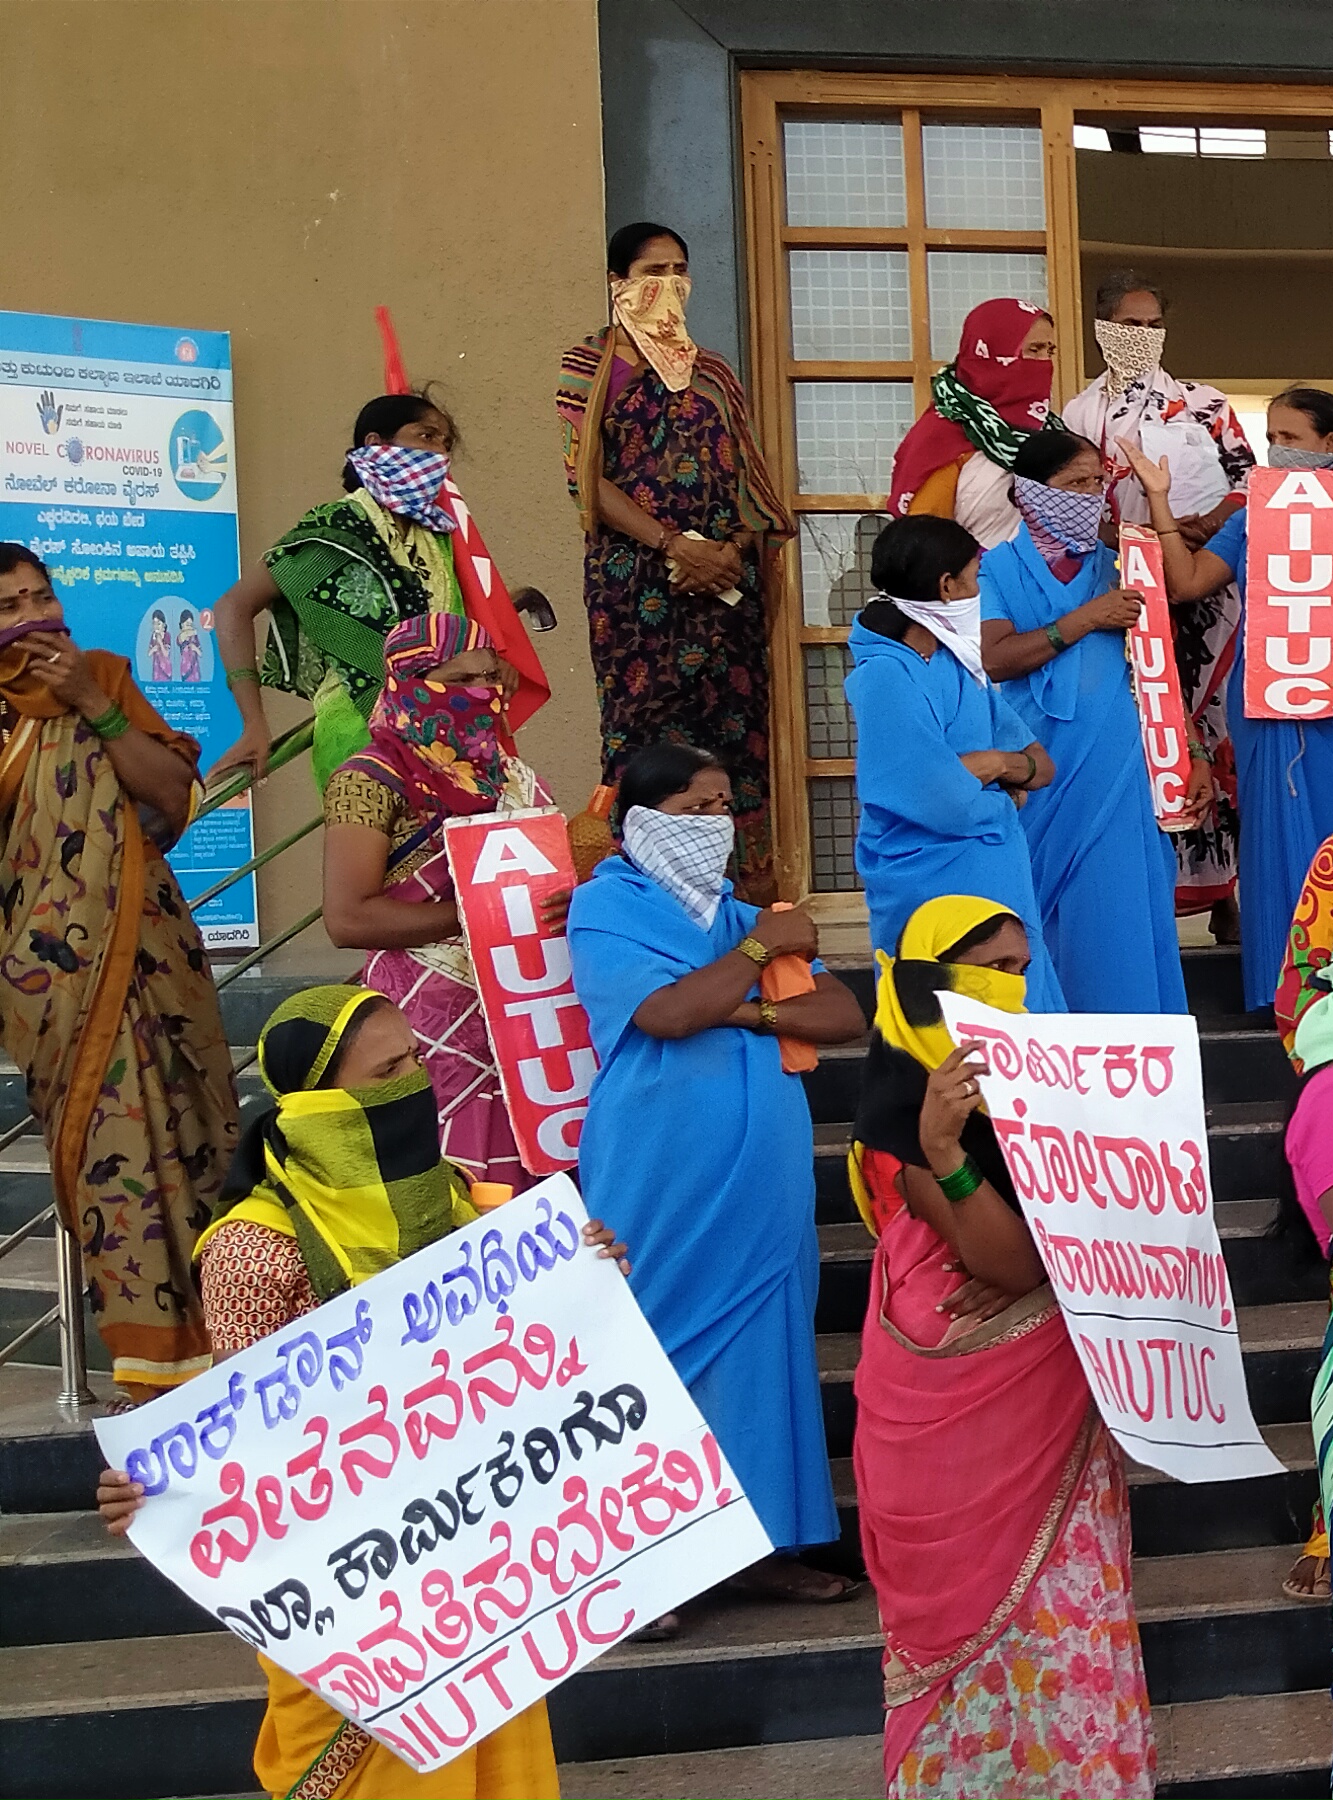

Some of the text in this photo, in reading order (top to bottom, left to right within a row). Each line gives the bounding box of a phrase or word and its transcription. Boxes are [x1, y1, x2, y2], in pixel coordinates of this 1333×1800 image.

[165, 376, 221, 390] ಯಾದಗಿರಿ
[6, 441, 49, 456] NOVEL
[122, 465, 163, 478] COVID-19
[64, 476, 118, 496] ಕರೋನಾ
[122, 479, 161, 505] ವೈರಸ್
[203, 610, 212, 629] 2
[208, 930, 250, 942] ಯಾದಗಿರಿ
[1079, 1333, 1226, 1425] AIUTUC
[189, 1315, 589, 1580] ವೇತನವನ್ನು
